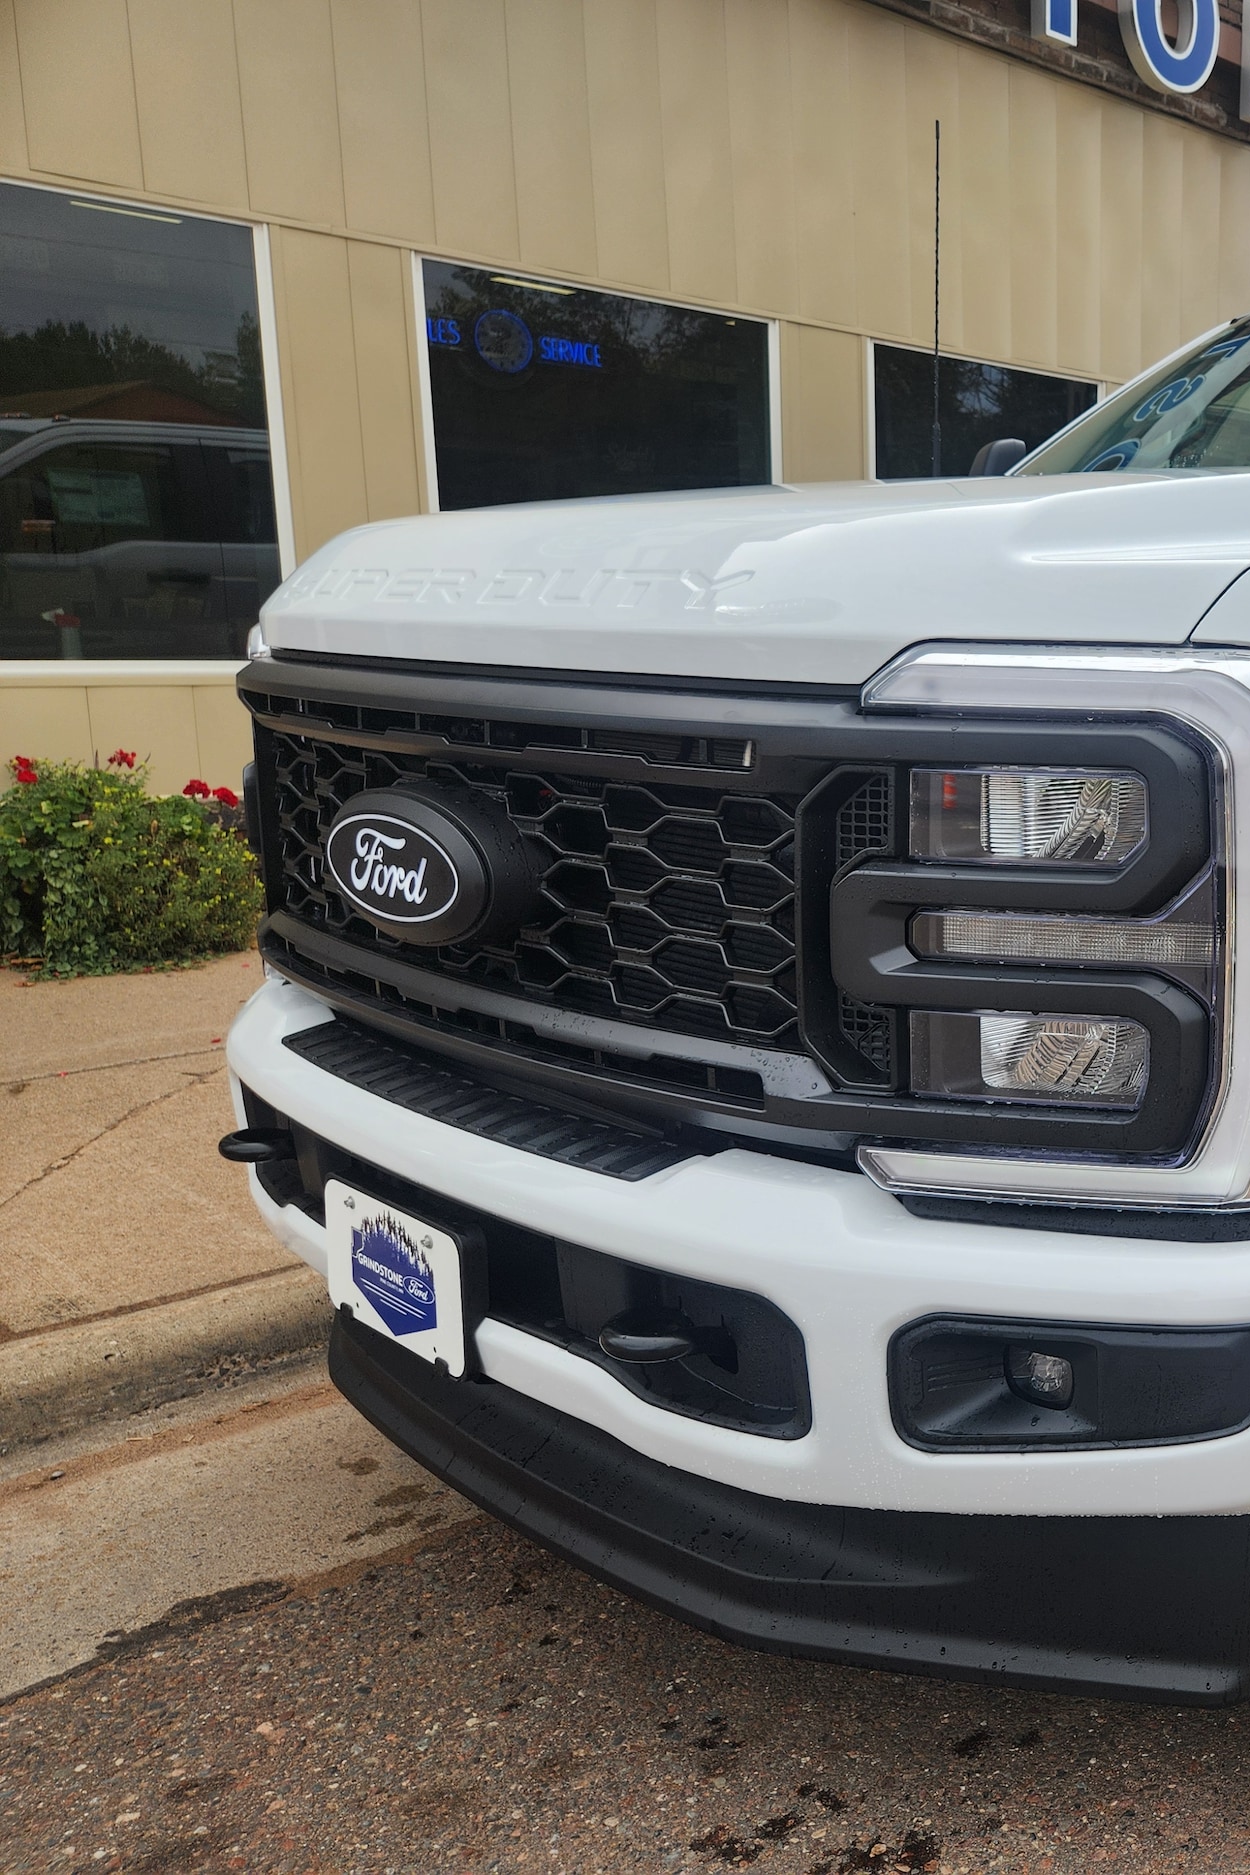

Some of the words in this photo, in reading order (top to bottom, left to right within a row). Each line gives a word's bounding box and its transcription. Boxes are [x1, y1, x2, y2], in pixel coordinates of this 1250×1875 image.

[539, 335, 603, 368] SERVICE
[476, 567, 756, 610] DUTY
[350, 827, 428, 905] Ford
[357, 1252, 404, 1288] GRINDSTONE
[408, 1279, 429, 1302] Ford
